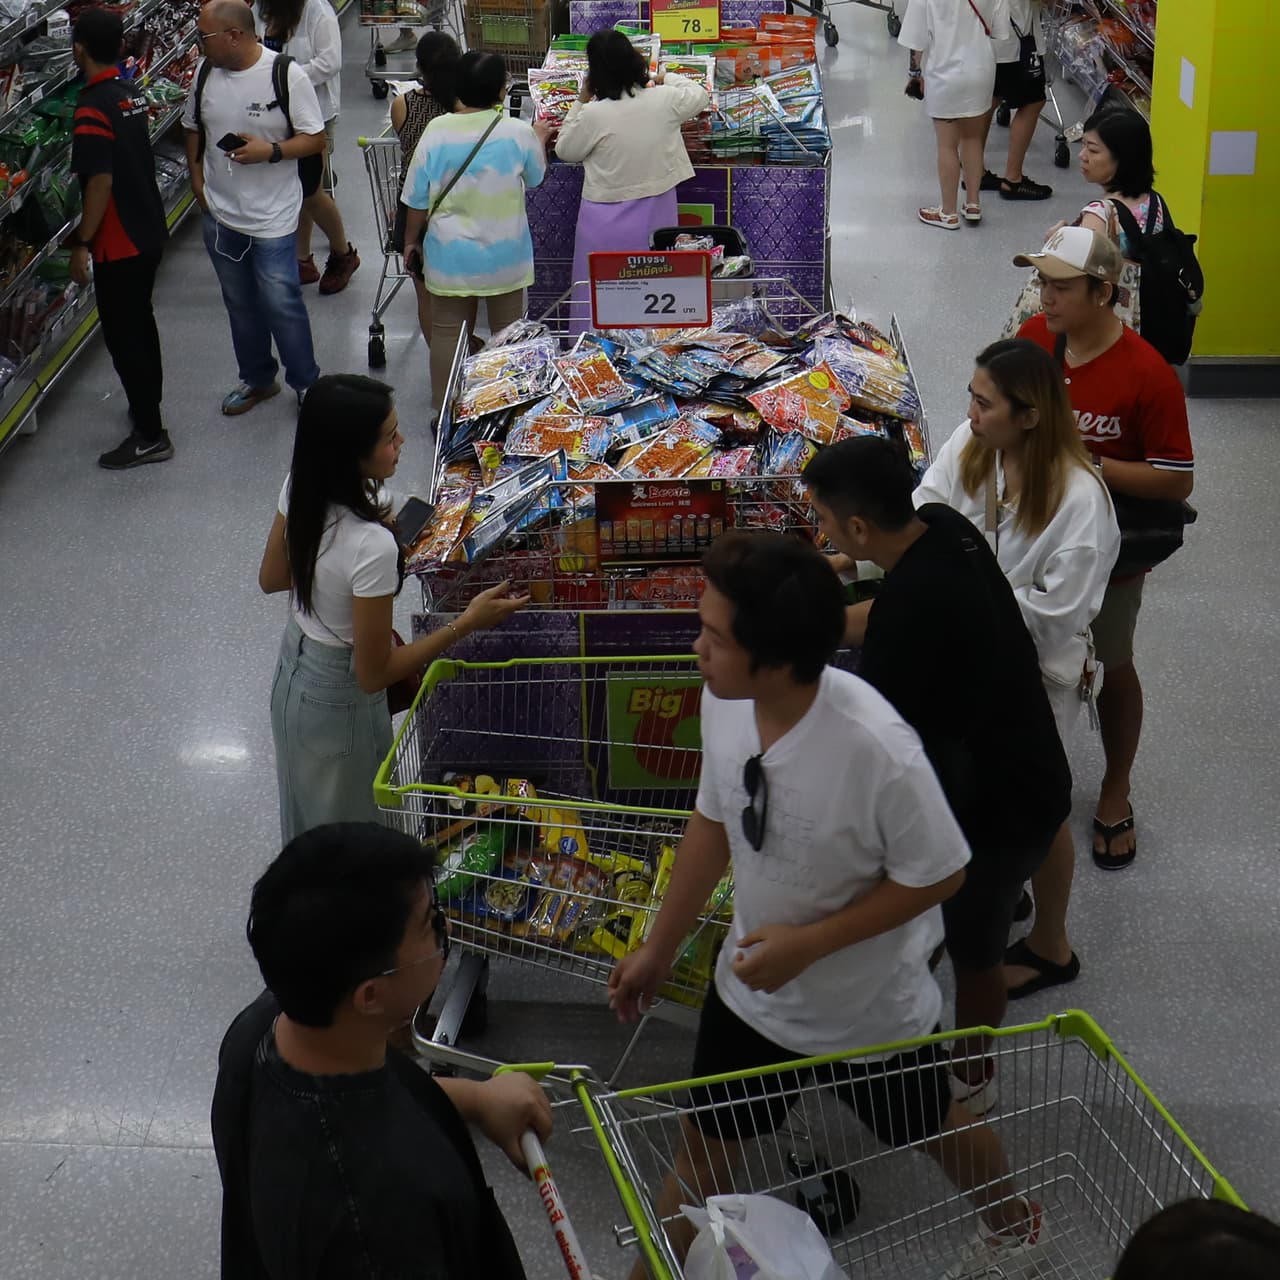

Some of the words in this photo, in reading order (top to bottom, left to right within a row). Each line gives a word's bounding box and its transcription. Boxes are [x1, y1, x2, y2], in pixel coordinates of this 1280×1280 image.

[681, 19, 701, 33] 78
[644, 293, 677, 315] 22
[627, 687, 684, 718] Big
